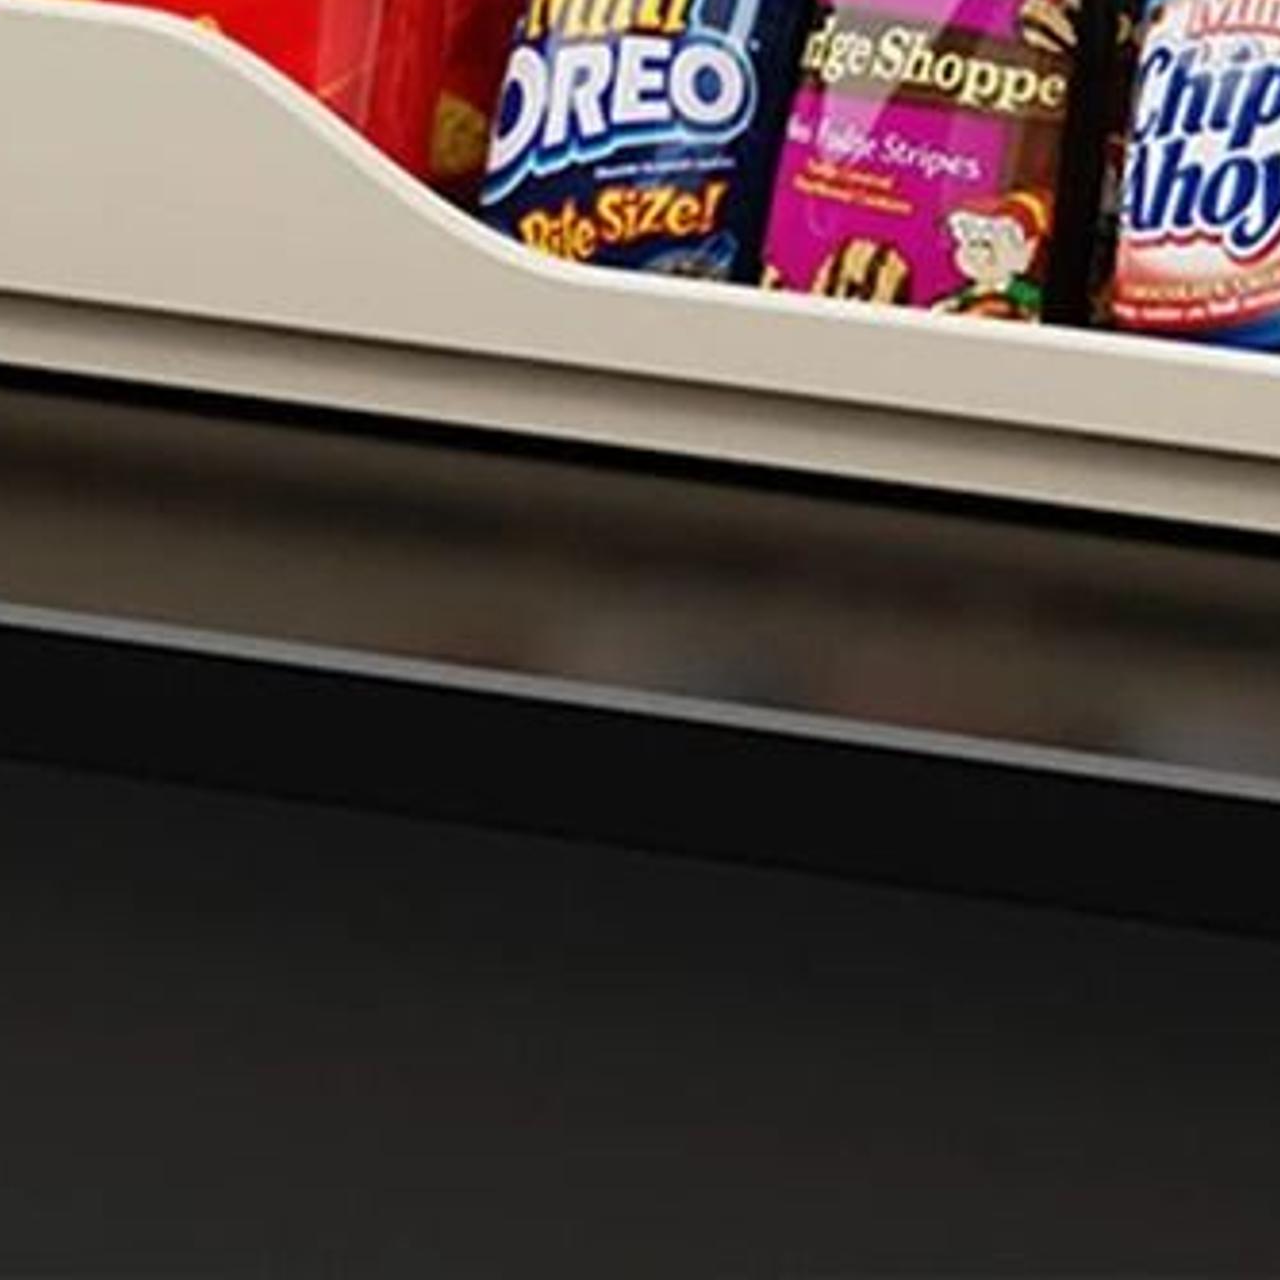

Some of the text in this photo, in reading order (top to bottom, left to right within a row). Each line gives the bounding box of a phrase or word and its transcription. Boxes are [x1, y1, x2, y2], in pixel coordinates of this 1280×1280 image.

[488, 39, 745, 172] OREO
[872, 26, 1068, 114] Shoppe
[596, 182, 728, 243] Size!
